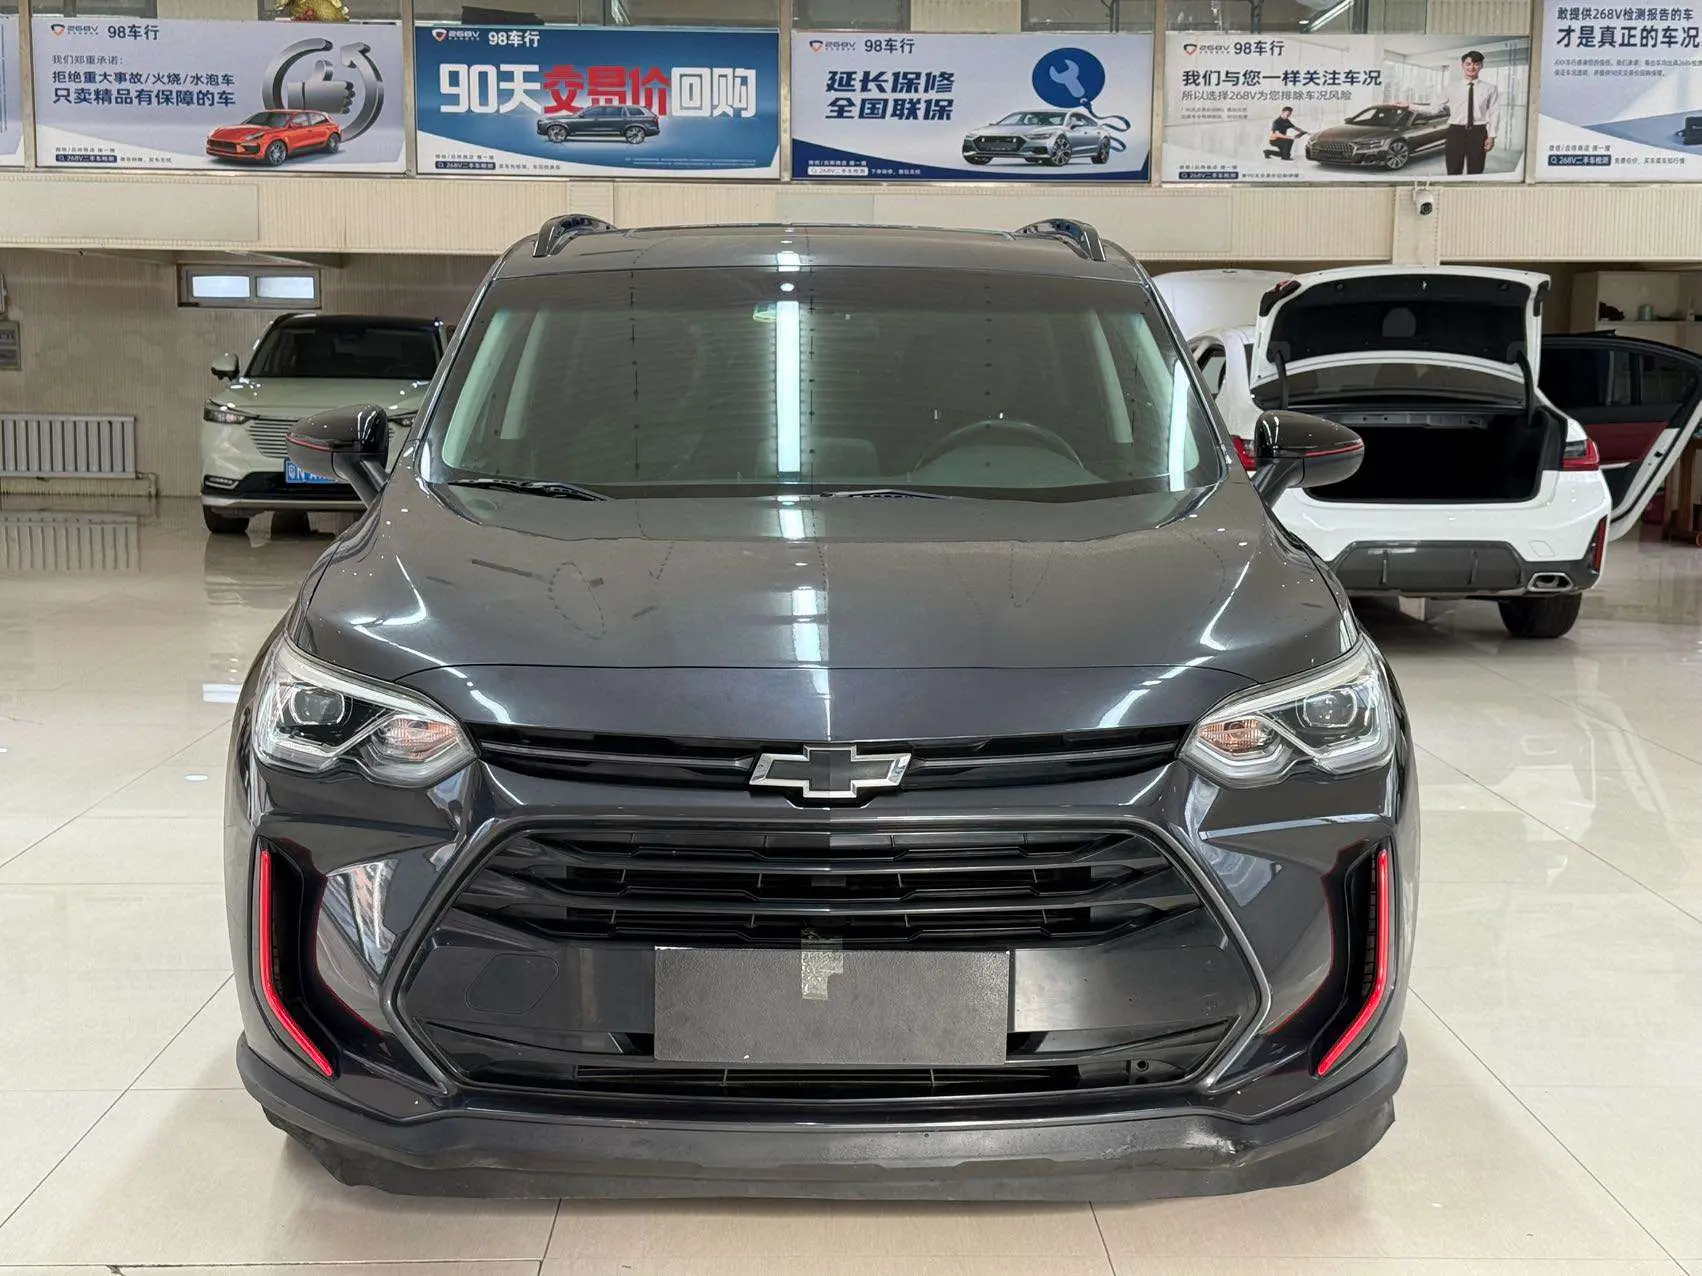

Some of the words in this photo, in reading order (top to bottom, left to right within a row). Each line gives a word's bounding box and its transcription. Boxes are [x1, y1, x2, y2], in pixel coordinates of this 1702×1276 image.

[1556, 7, 1694, 21] 敢提供268V检测报告的车
[107, 24, 160, 40] 98车行
[488, 30, 541, 47] 98车行
[1556, 25, 1701, 48] 才是真正的车况
[864, 38, 915, 54] 98车行
[1233, 40, 1285, 56] 98车行
[52, 71, 236, 87] 拒绝重大事故/火烧/水泡车
[825, 71, 955, 94] 延长保修
[1182, 69, 1383, 87] 我们与您一样关注车况
[53, 88, 236, 108] 只卖精品有保障的车
[439, 63, 757, 118] 90天交易价回购
[1181, 90, 1353, 101] 所以选择268V为您排除车况风险
[825, 97, 954, 121] 全国联保
